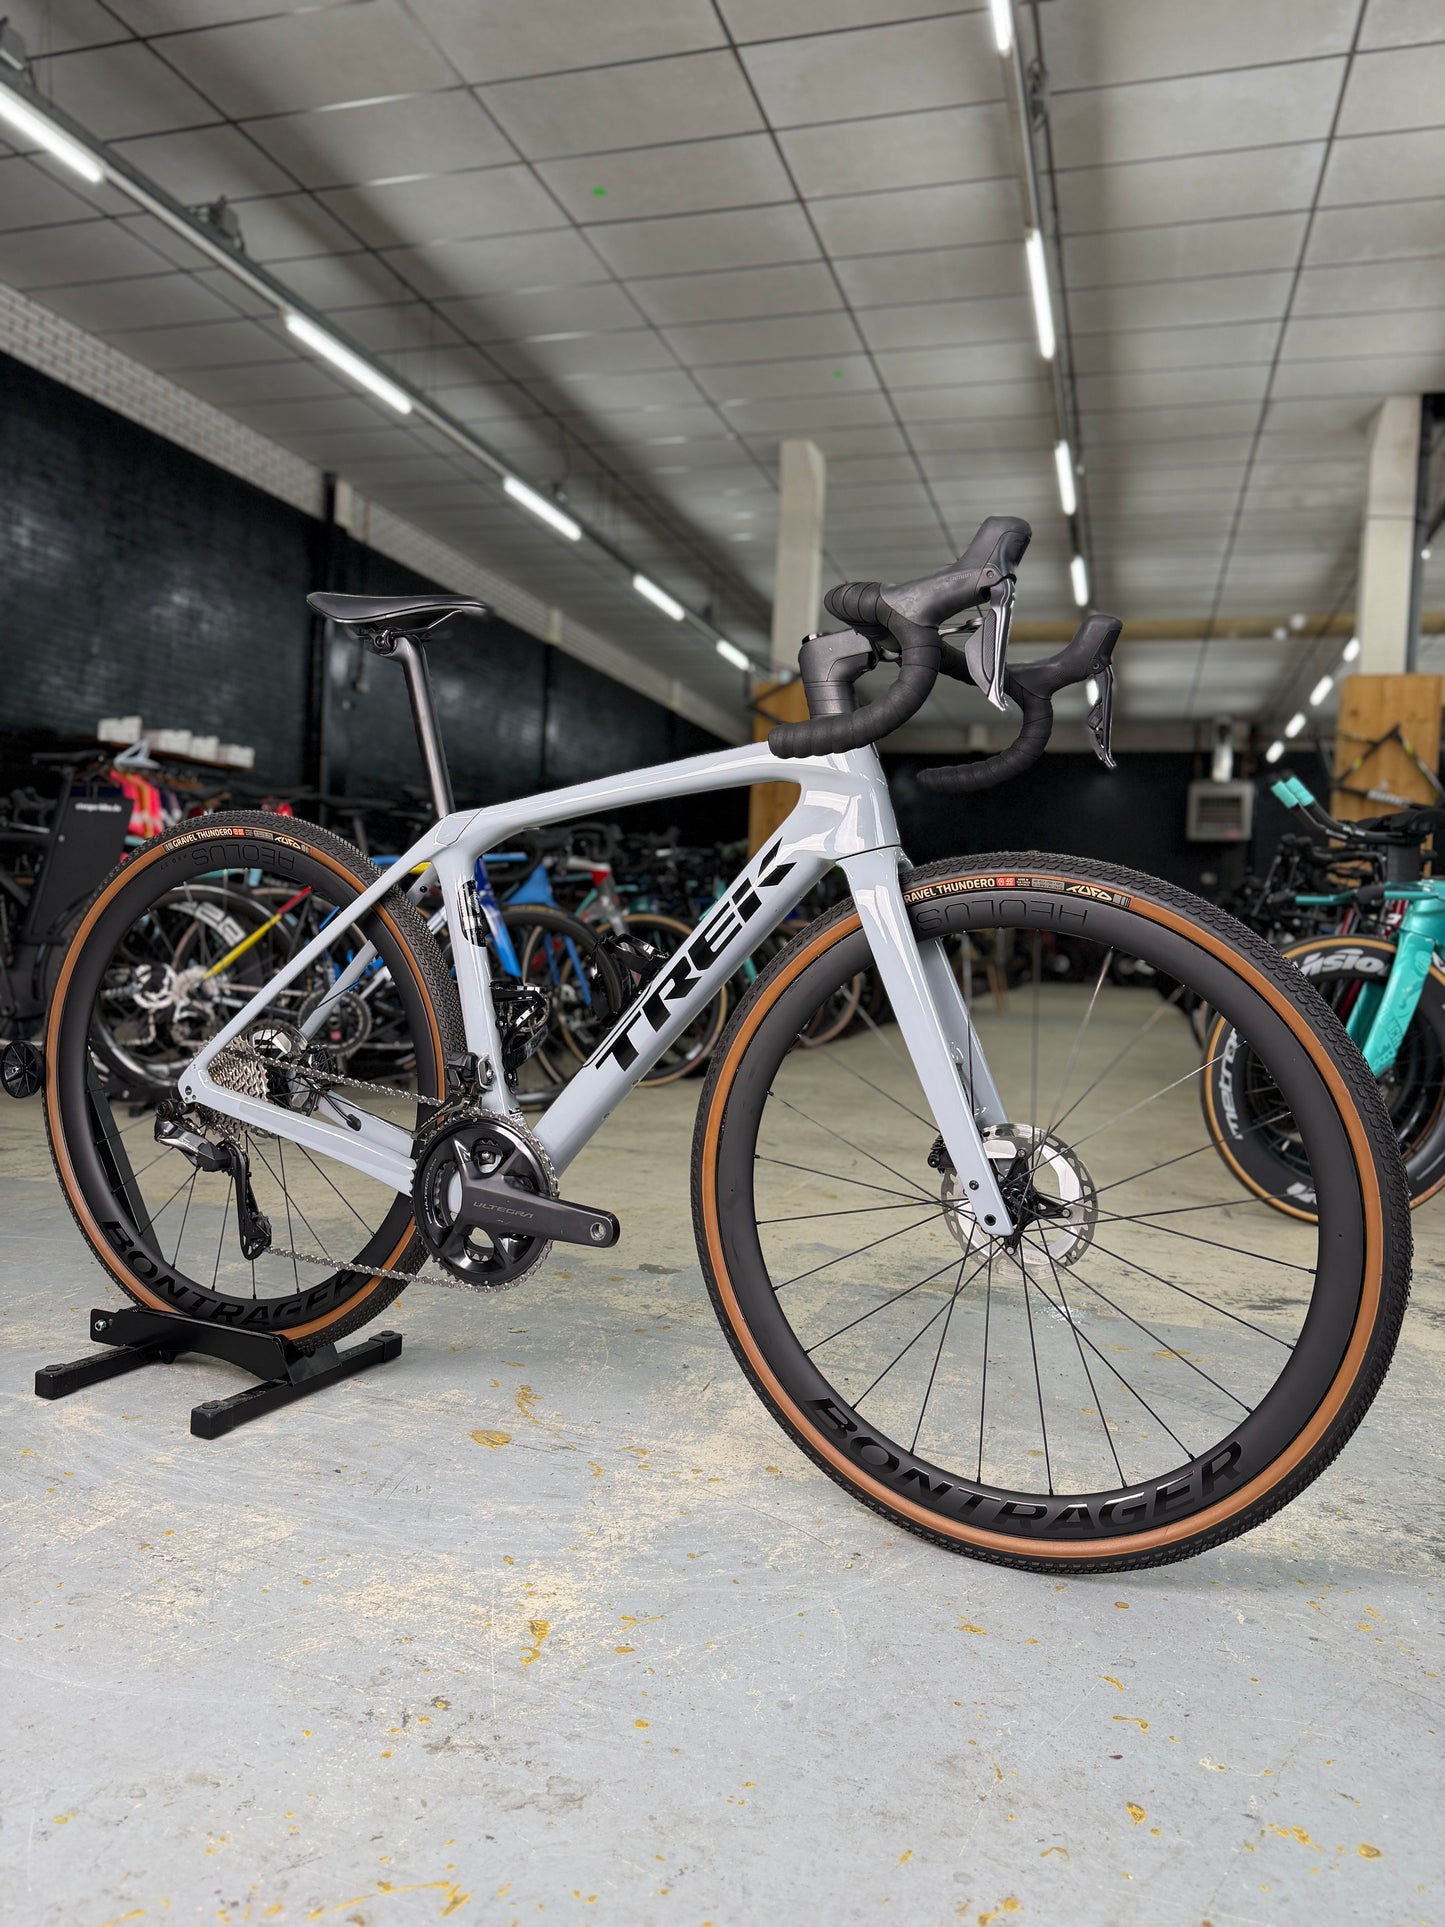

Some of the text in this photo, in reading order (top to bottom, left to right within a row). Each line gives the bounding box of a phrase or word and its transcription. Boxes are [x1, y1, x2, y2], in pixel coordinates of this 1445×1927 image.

[172, 835, 198, 848] GRAVEL
[197, 828, 233, 839] THUNDERO
[191, 843, 295, 871] AEOLUS
[903, 886, 936, 904] RAVEL
[936, 877, 995, 897] THUNDERO
[1066, 884, 1112, 902] TUFO
[915, 899, 1088, 931] AEOLUS
[595, 836, 797, 1072] TREK
[473, 1201, 534, 1219] ULTEGRA
[101, 1220, 353, 1325] BONTRAGER
[811, 1397, 1242, 1532] BONTRAGER
